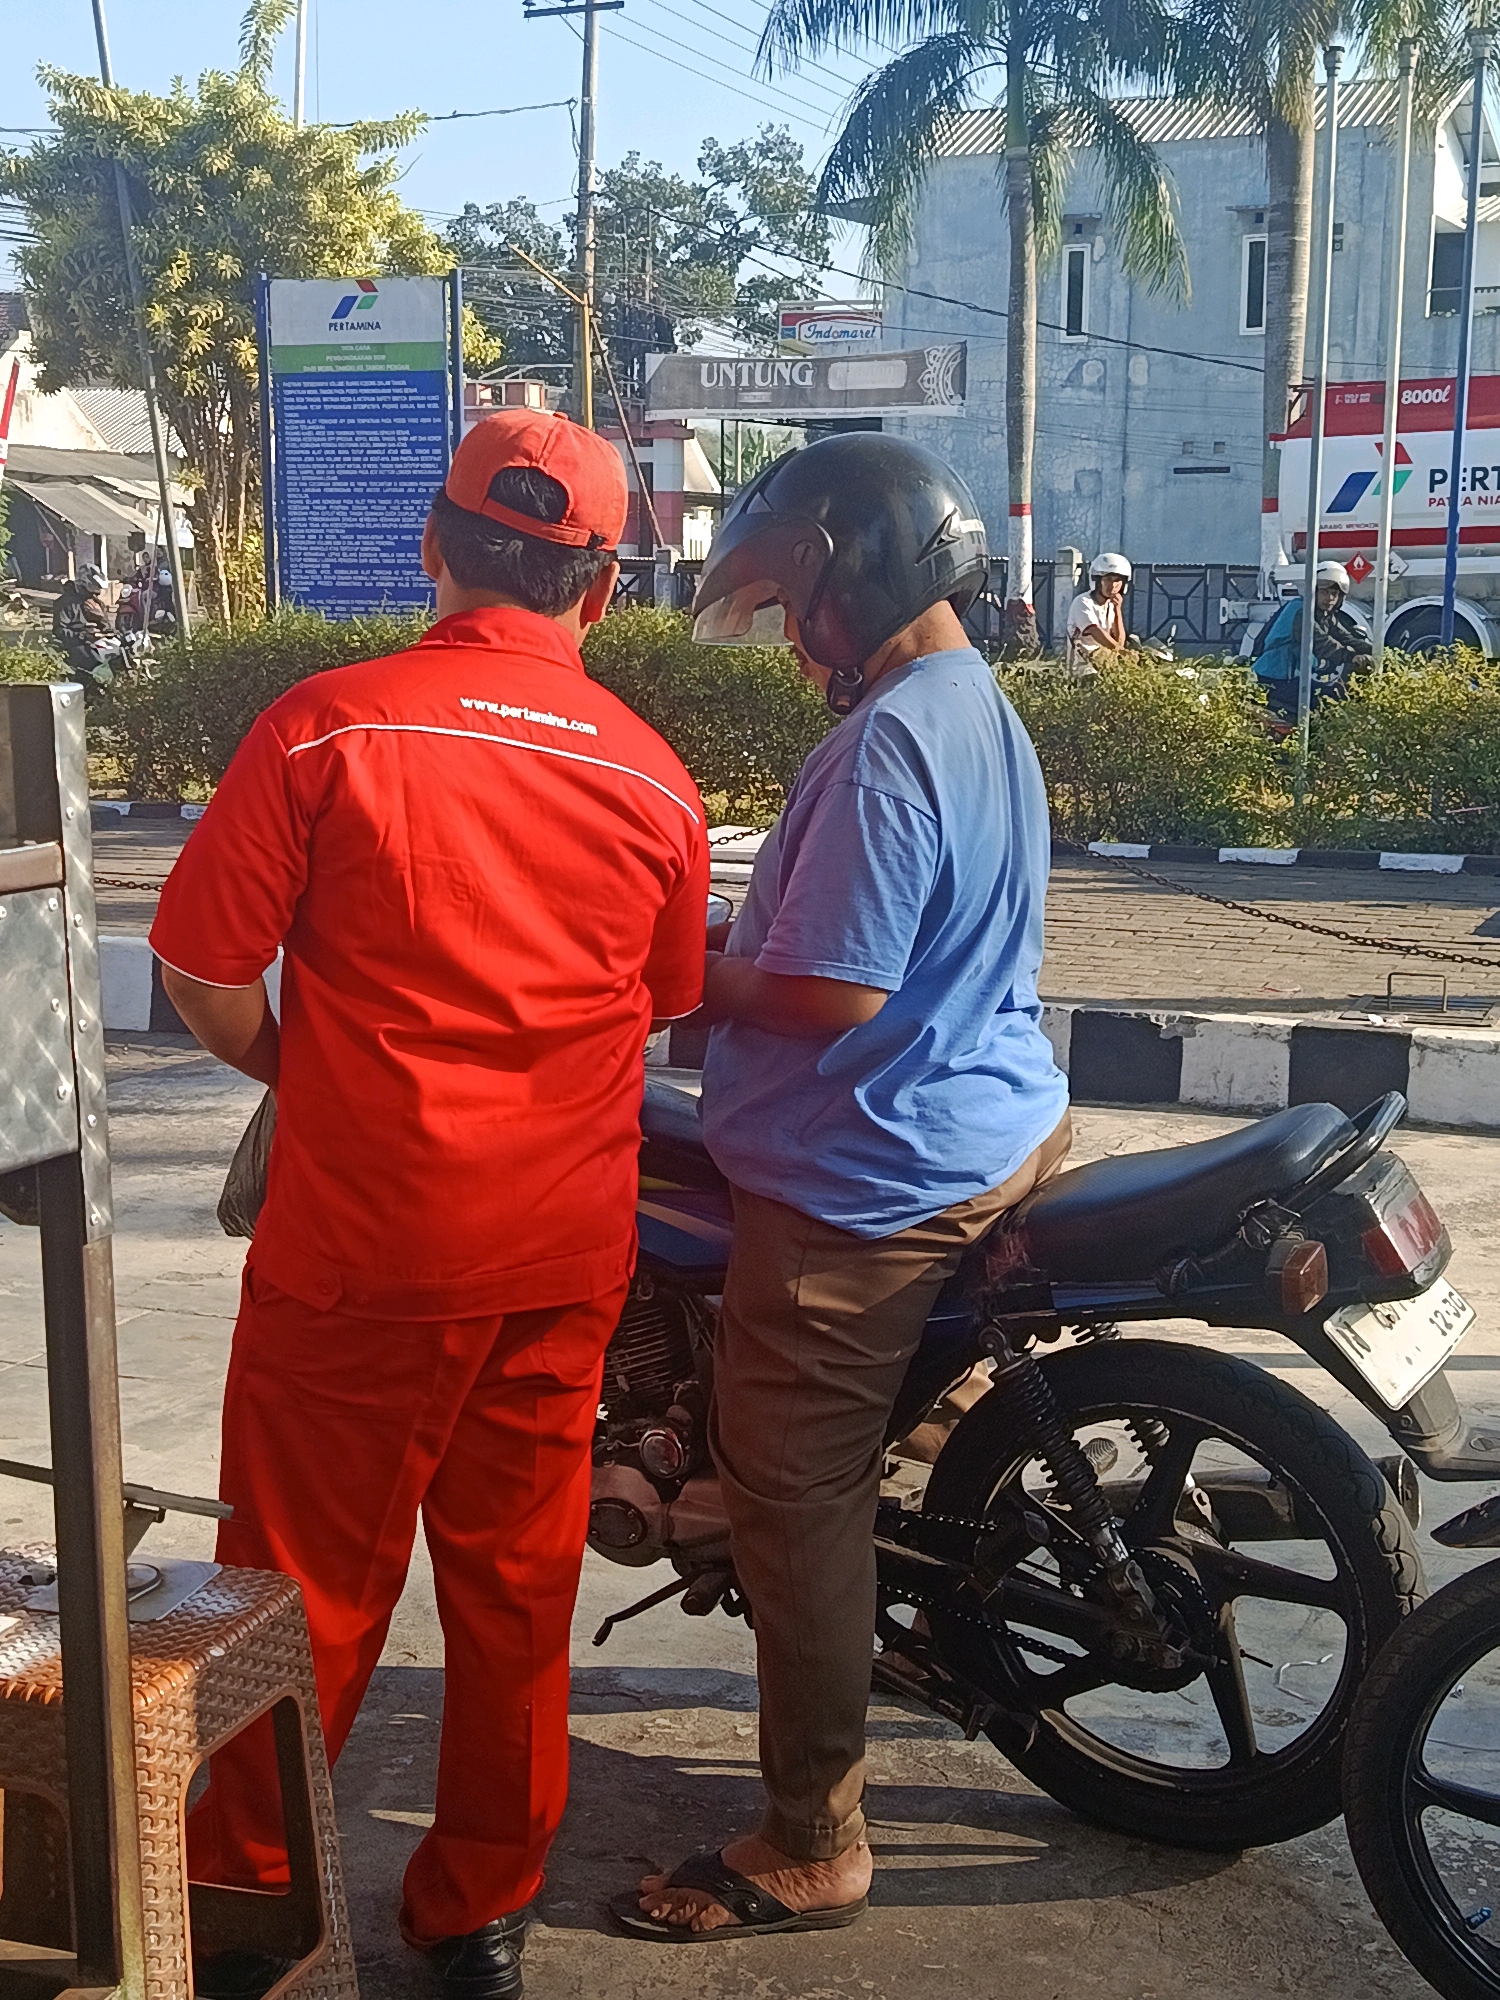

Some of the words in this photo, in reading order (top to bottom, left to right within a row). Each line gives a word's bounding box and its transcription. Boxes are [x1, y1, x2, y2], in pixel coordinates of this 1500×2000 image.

[329, 322, 381, 331] PERTAMINA
[804, 323, 877, 340] Indomaret
[699, 361, 815, 389] UNTUNG
[459, 696, 598, 736] www.pertamina.com
